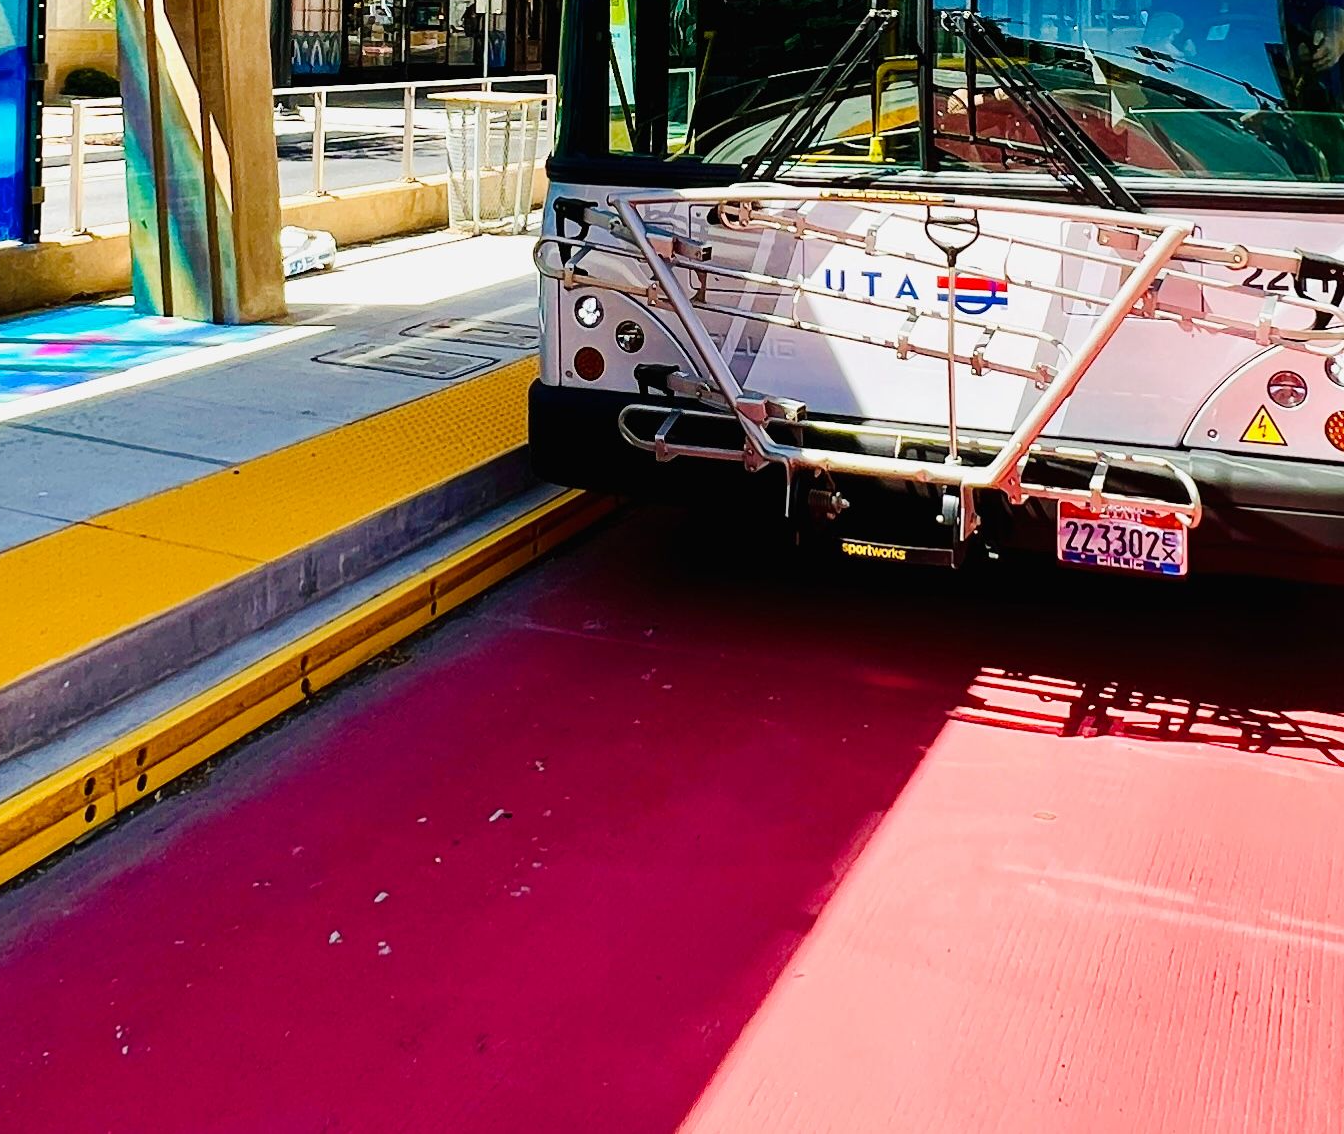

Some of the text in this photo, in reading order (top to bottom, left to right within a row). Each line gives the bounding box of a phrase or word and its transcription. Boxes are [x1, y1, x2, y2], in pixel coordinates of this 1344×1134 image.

[825, 269, 919, 300] UTA
[841, 542, 906, 560] sportworks
[1065, 521, 1160, 561] 223302
[1097, 555, 1145, 571] GILLIG
